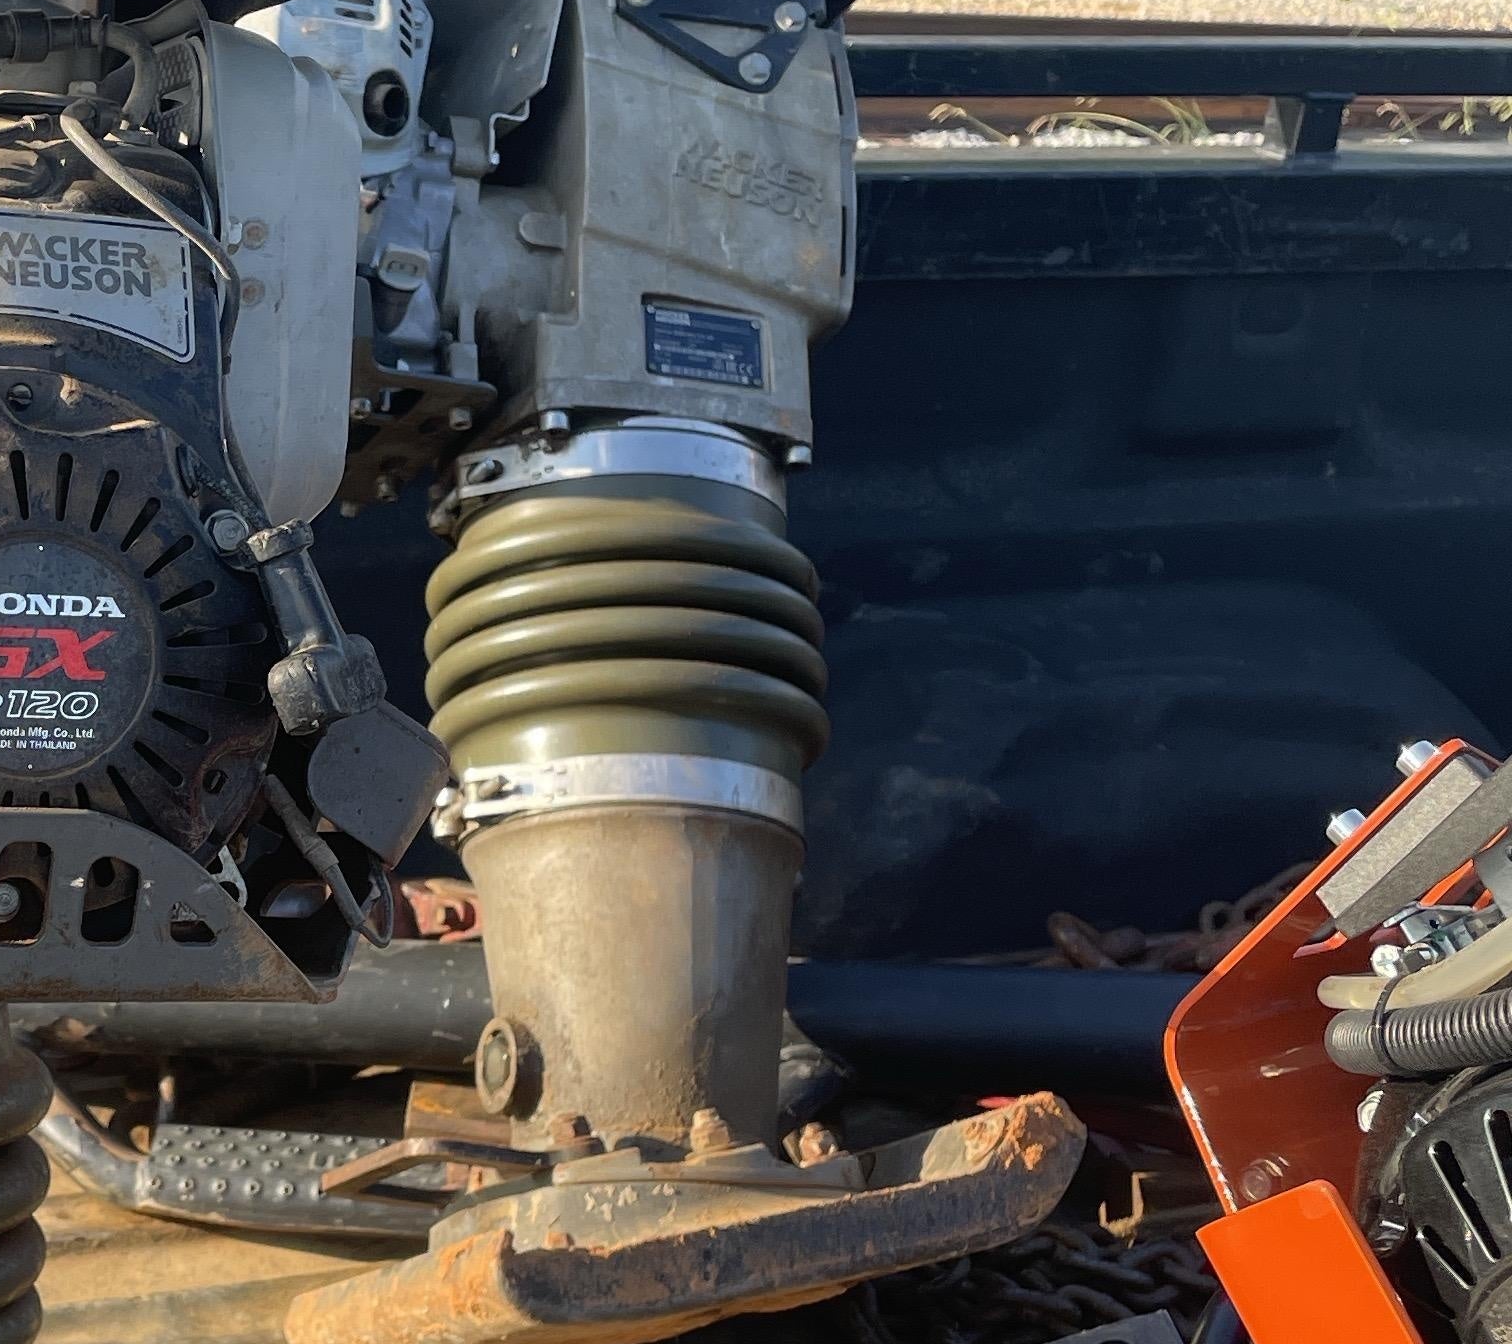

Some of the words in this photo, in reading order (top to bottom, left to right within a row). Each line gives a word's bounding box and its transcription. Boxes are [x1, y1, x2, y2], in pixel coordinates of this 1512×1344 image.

[28, 727, 52, 739] Mfg.
[54, 728, 74, 739] Co.,
[76, 728, 96, 739] Ltd.
[16, 740, 28, 749] IN
[29, 741, 77, 750] THAILAND
